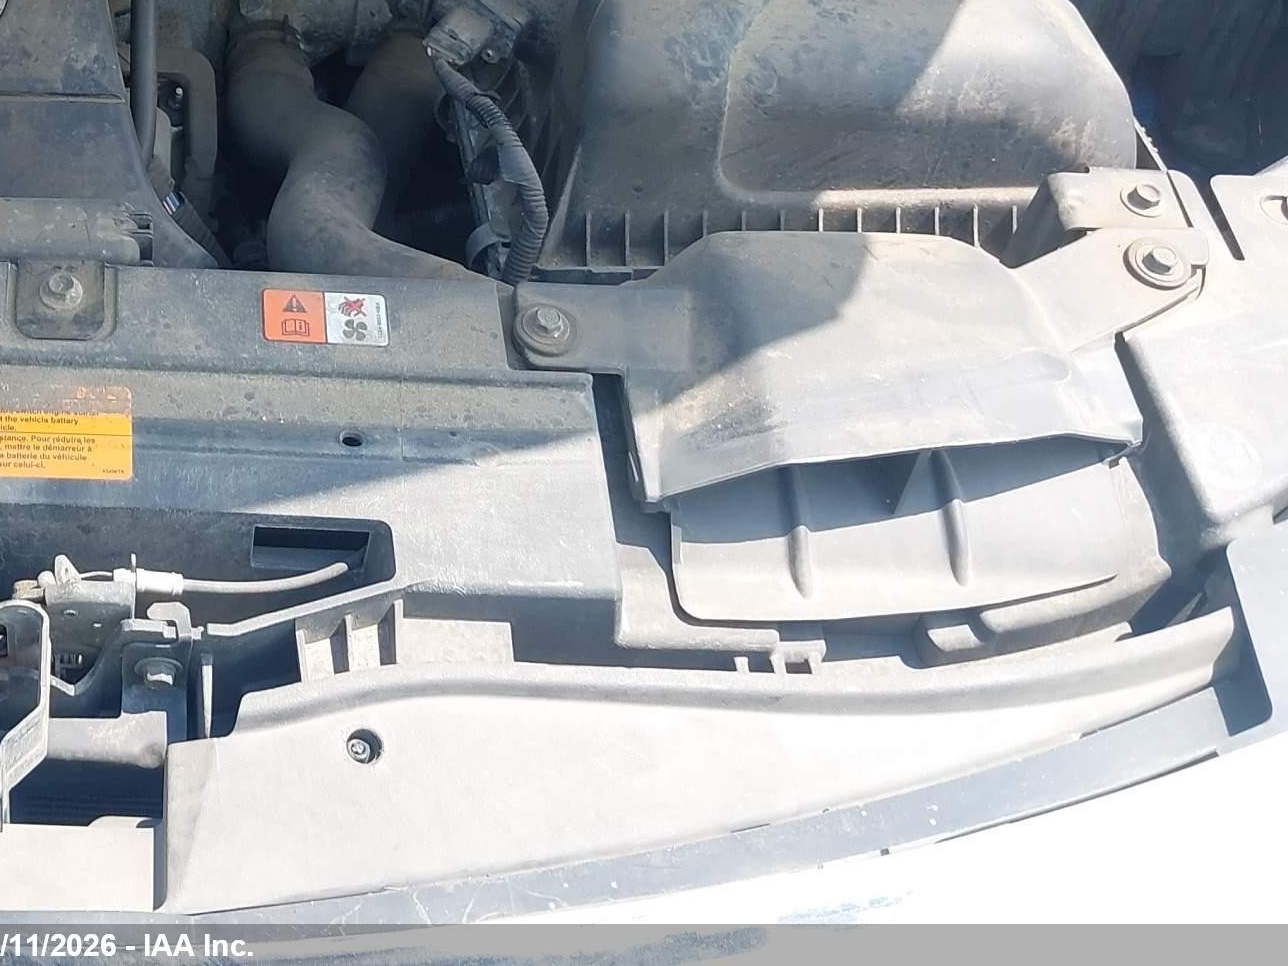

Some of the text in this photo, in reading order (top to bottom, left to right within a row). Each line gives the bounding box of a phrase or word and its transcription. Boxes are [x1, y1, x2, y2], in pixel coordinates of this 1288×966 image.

[20, 416, 49, 424] vehicle
[50, 417, 79, 425] battery
[30, 434, 50, 443] Pour
[52, 435, 82, 444] réduire
[83, 436, 96, 444] les
[42, 444, 85, 452] démarreur
[6, 452, 38, 460] batterie
[39, 452, 51, 460] du
[52, 453, 88, 461] véhicule
